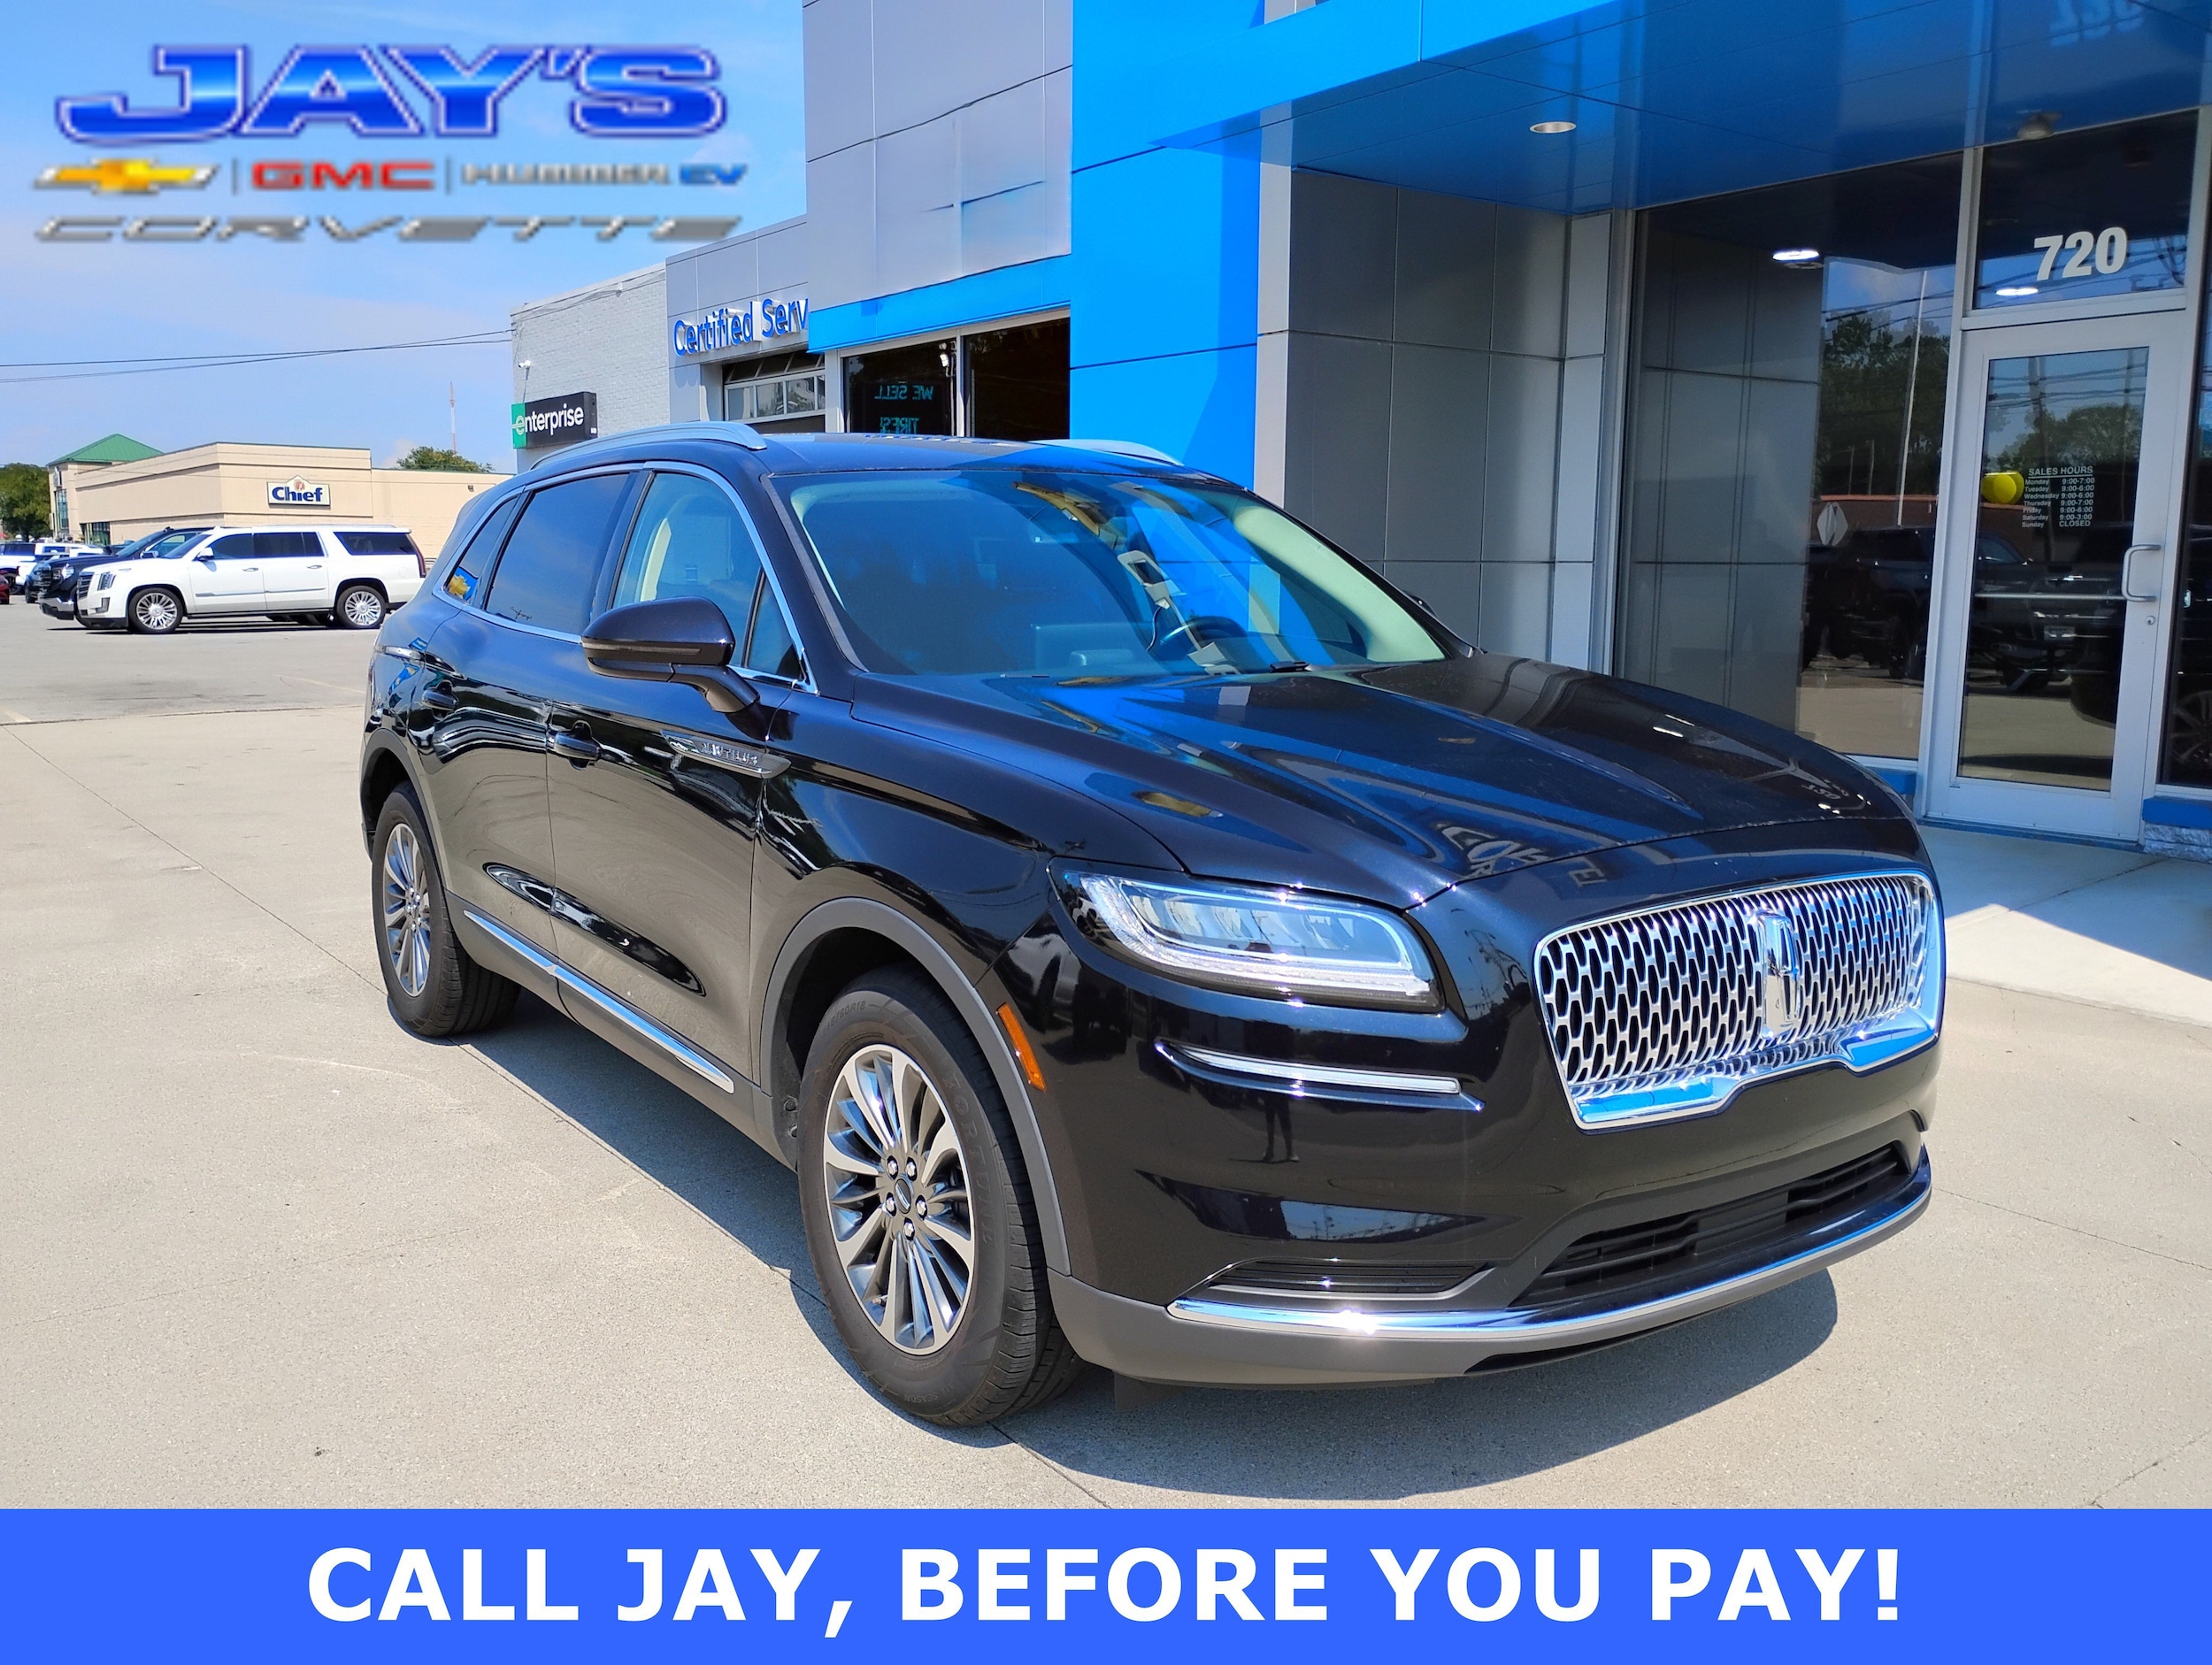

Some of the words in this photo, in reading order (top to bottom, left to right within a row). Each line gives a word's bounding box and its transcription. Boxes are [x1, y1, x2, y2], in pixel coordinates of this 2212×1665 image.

[2033, 226, 2128, 281] 720
[674, 301, 754, 357] Certified
[762, 298, 809, 338] Serv
[512, 403, 584, 435] enterprise
[2028, 467, 2058, 476] SALES
[2060, 465, 2093, 474] HOURS
[272, 486, 323, 502] Chief
[943, 1071, 996, 1247] FORTUNE
